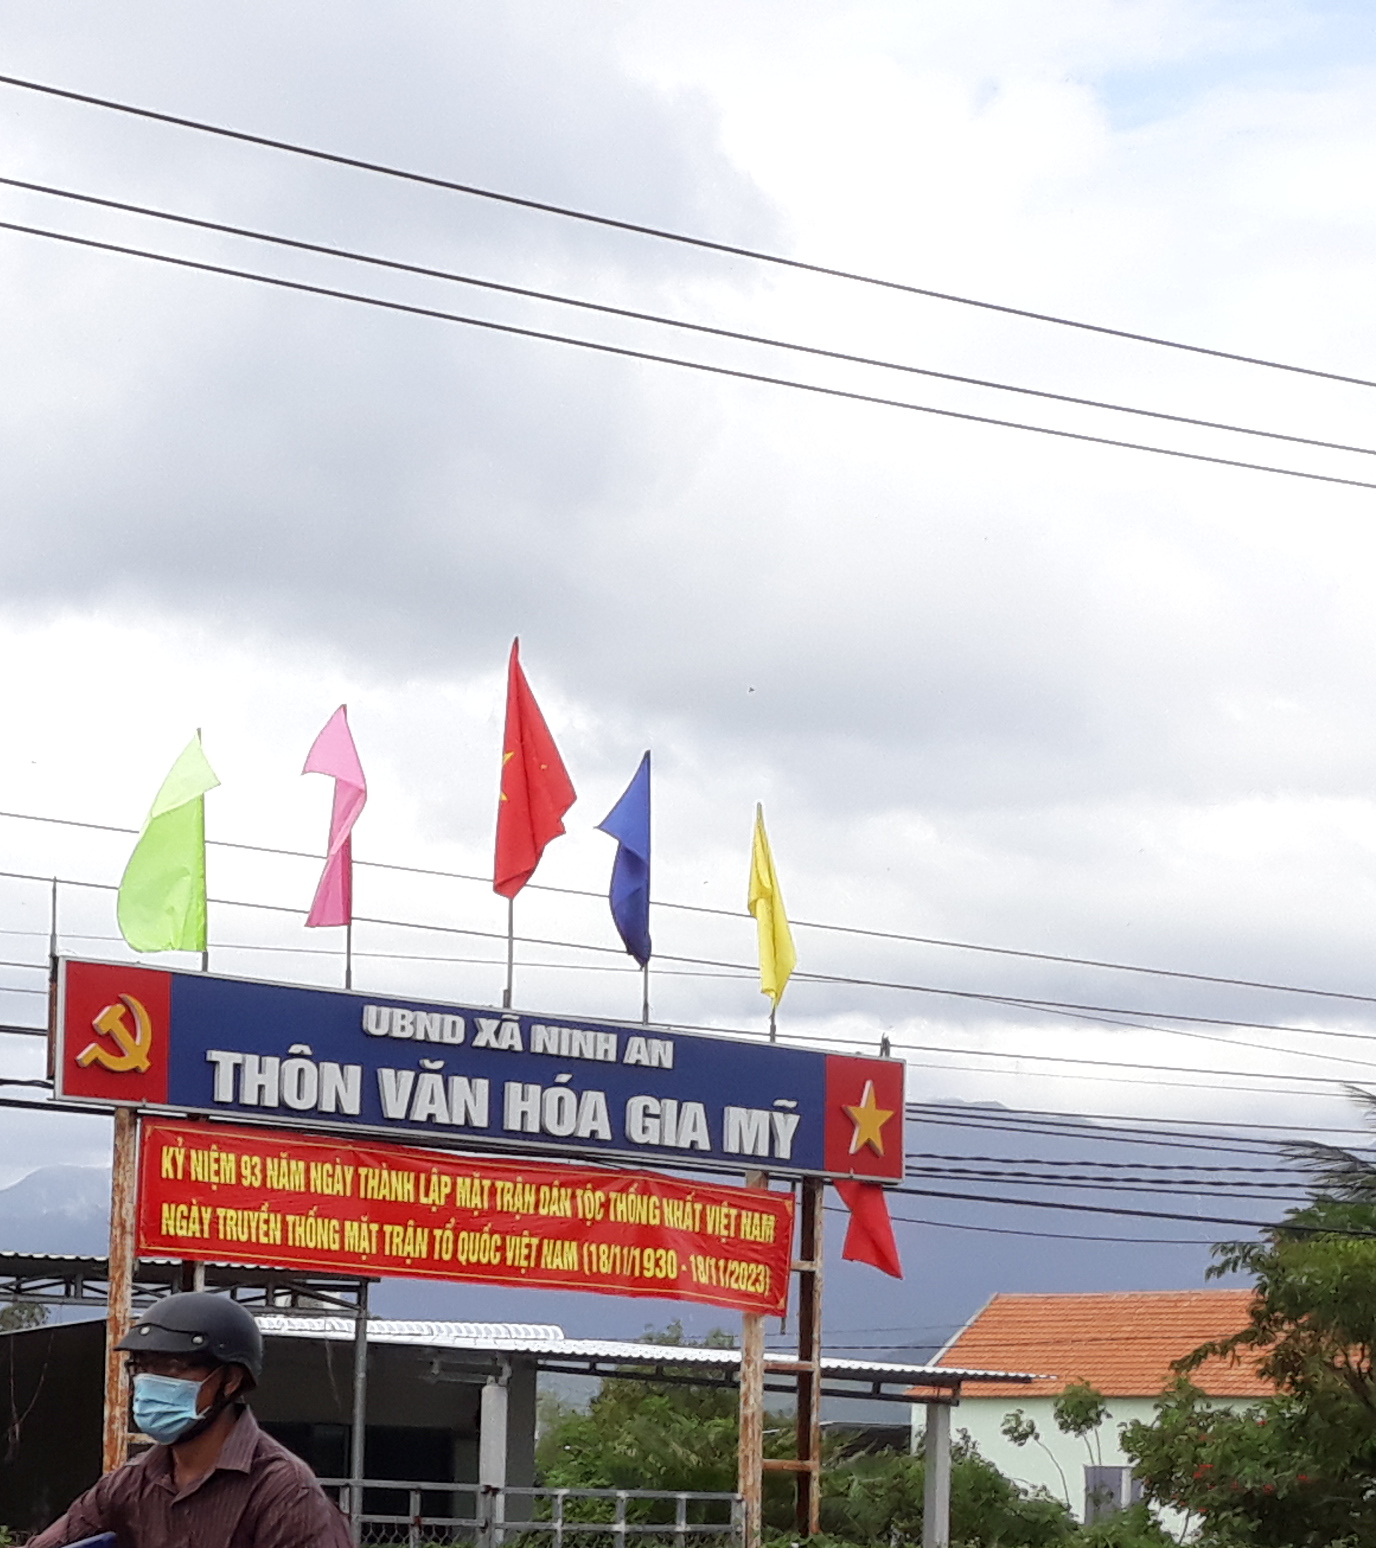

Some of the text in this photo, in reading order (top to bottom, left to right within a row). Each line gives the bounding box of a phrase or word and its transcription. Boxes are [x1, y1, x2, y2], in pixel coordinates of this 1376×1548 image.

[363, 1004, 675, 1070] UBND XÃ NINH AN
[205, 1043, 801, 1160] THÔN VĂN HÓA GIA MỸ
[161, 1136, 776, 1244] KỶ NIỆM 93 NĂM NGÀY THÀNH LẬP MẶT TRẬN DÂN TỘC THỐNG NHẤT VIỆT NAM
[160, 1198, 213, 1239] NGÀY
[286, 1205, 341, 1251] THỐNG
[344, 1215, 380, 1260] MẶT
[383, 1219, 429, 1265] TRẬN
[433, 1217, 455, 1261] TỔ
[458, 1223, 502, 1266] QUỐC
[505, 1230, 540, 1274] VIỆT
[541, 1238, 579, 1271] NAM
[583, 1241, 678, 1280] (18/11/1930
